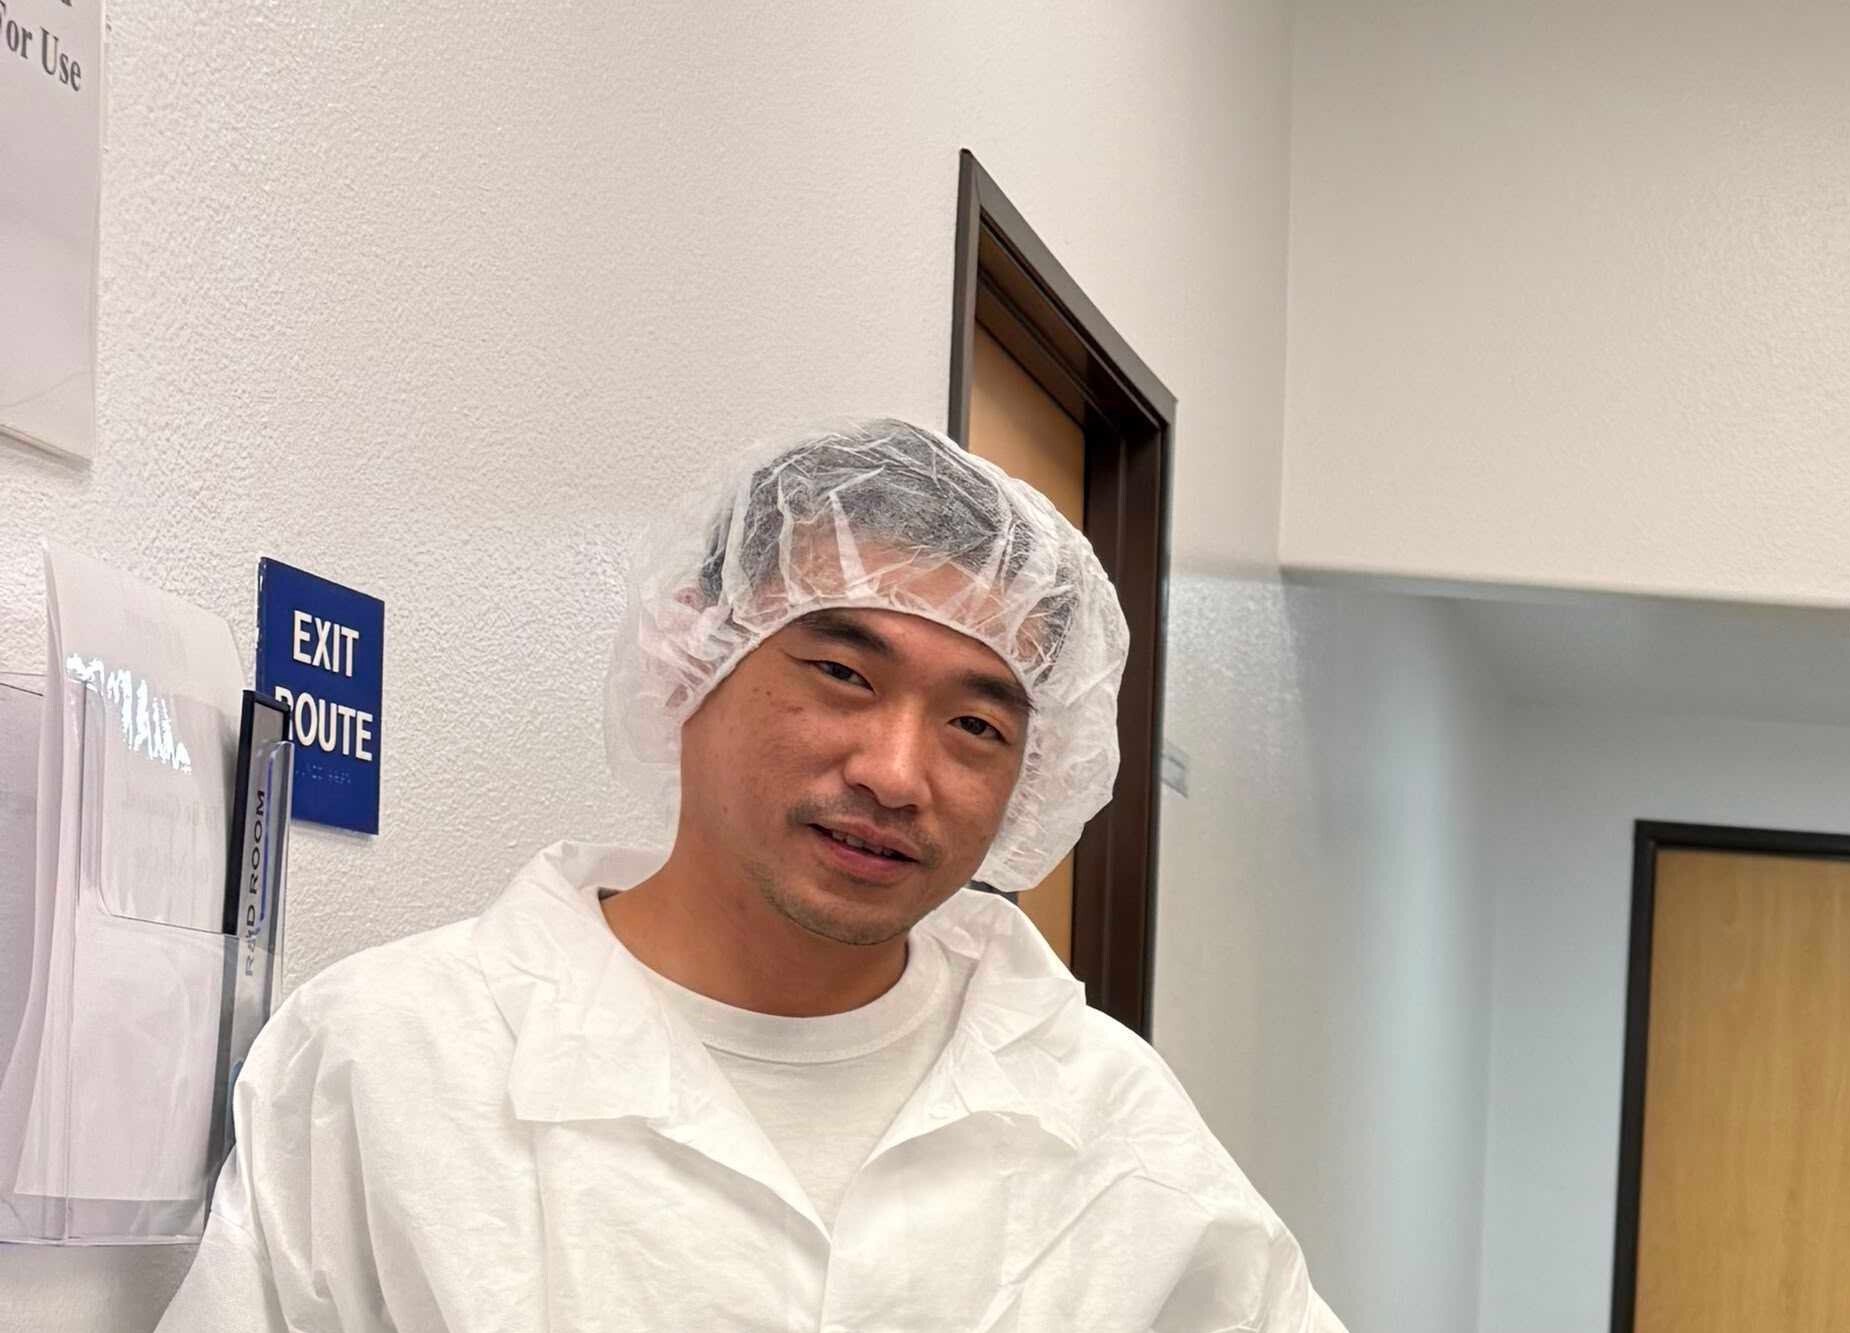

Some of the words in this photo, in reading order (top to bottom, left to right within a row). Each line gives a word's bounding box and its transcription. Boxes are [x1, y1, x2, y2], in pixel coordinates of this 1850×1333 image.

[40, 26, 81, 92] Use
[293, 610, 360, 677] EXIT
[249, 790, 266, 894] ROOM
